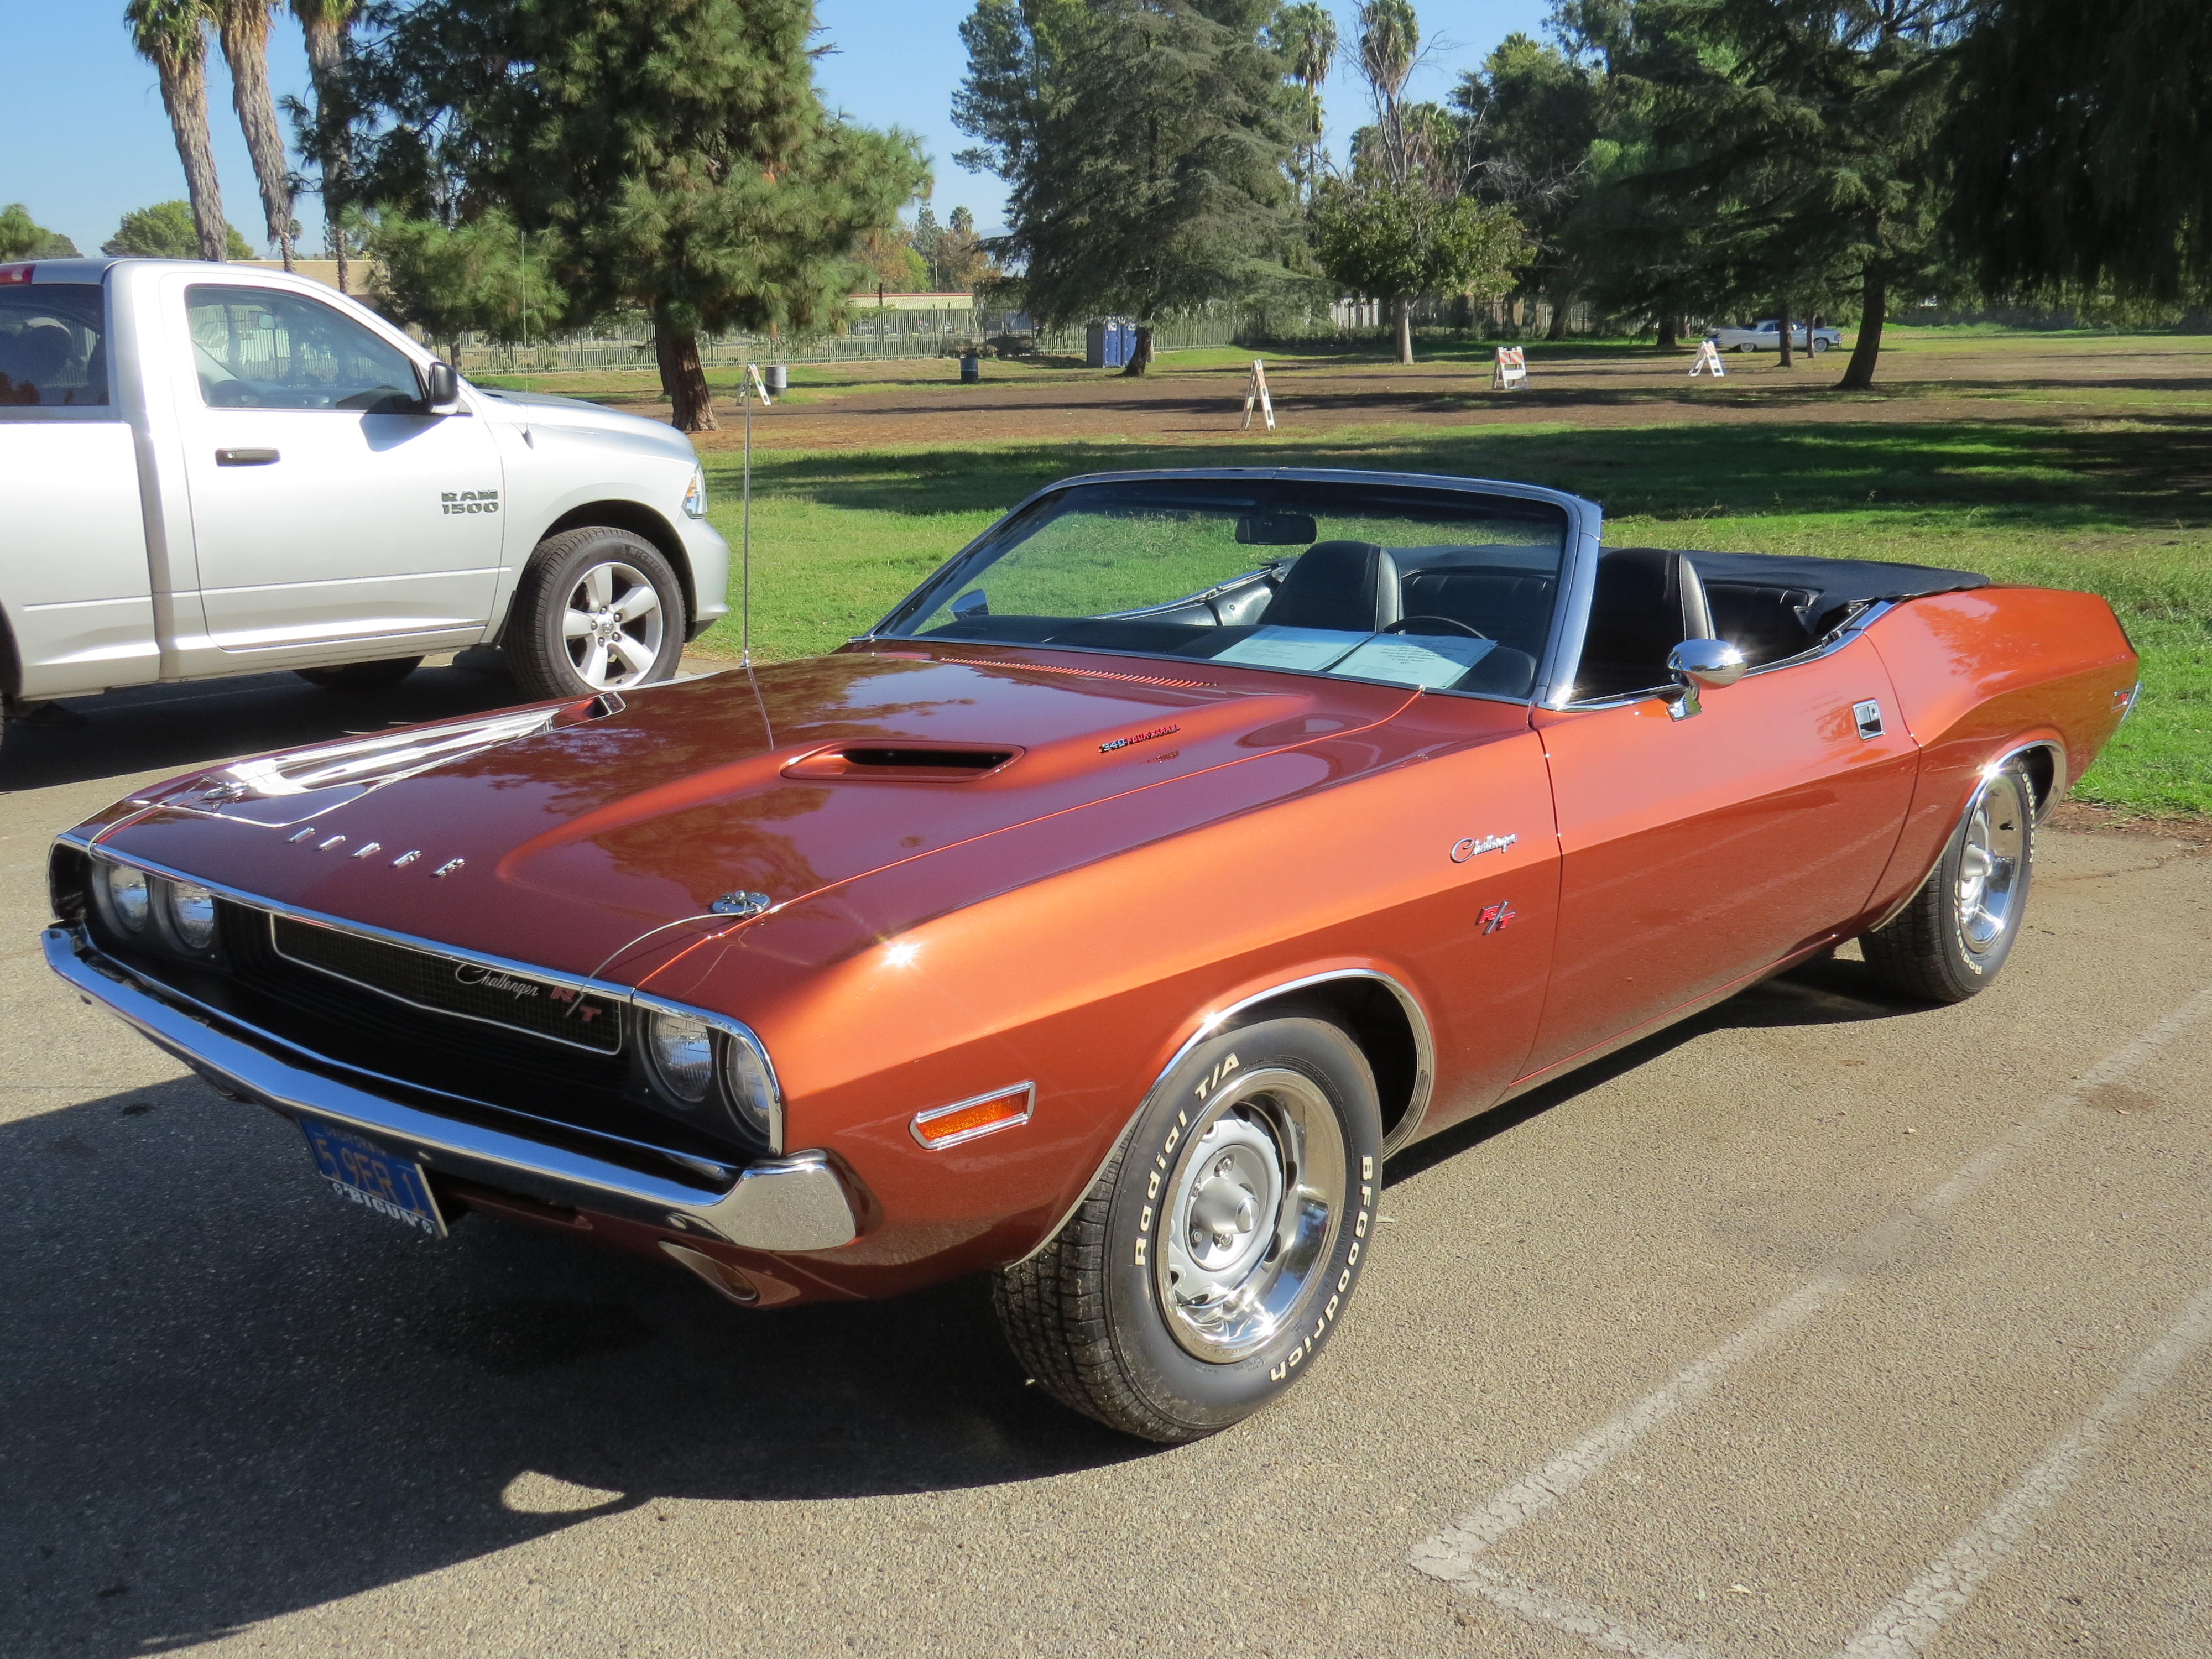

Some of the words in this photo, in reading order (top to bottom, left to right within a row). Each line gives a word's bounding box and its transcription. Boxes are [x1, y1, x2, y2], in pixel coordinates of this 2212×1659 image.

[441, 489, 498, 502] RAM
[442, 501, 499, 514] 1500
[1099, 738, 1126, 753] 340
[1450, 833, 1517, 864] Challenger
[1474, 900, 1516, 936] R/T
[455, 963, 539, 1000] Challenger
[550, 986, 602, 1022] R/T
[1134, 1109, 1188, 1267] Radial
[1193, 1051, 1241, 1102] T/A
[1269, 1155, 1374, 1384] BFGoodrich
